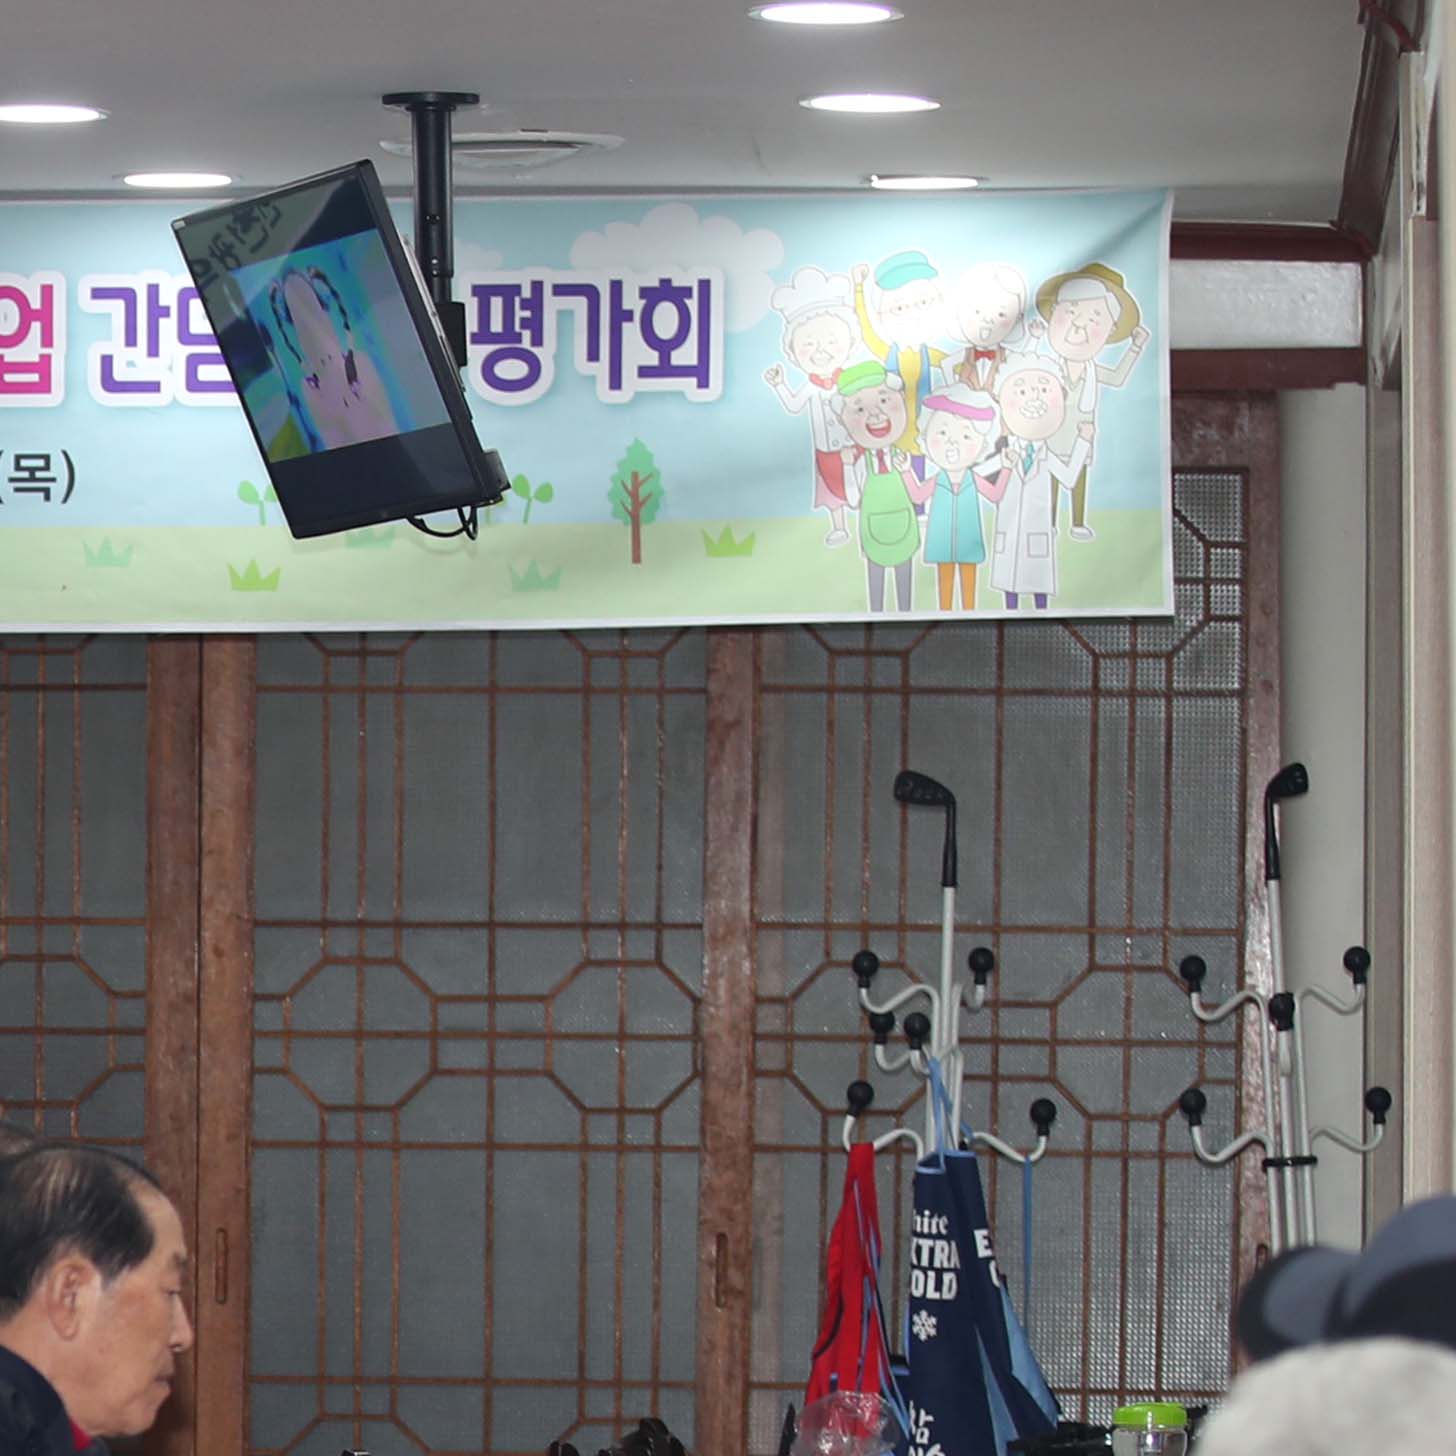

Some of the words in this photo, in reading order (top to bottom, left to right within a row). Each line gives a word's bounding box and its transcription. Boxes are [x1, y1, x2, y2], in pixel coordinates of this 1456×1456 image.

[471, 280, 711, 393] 평가회
[911, 1236, 961, 1270] XTRA
[910, 1268, 958, 1300] OLD
